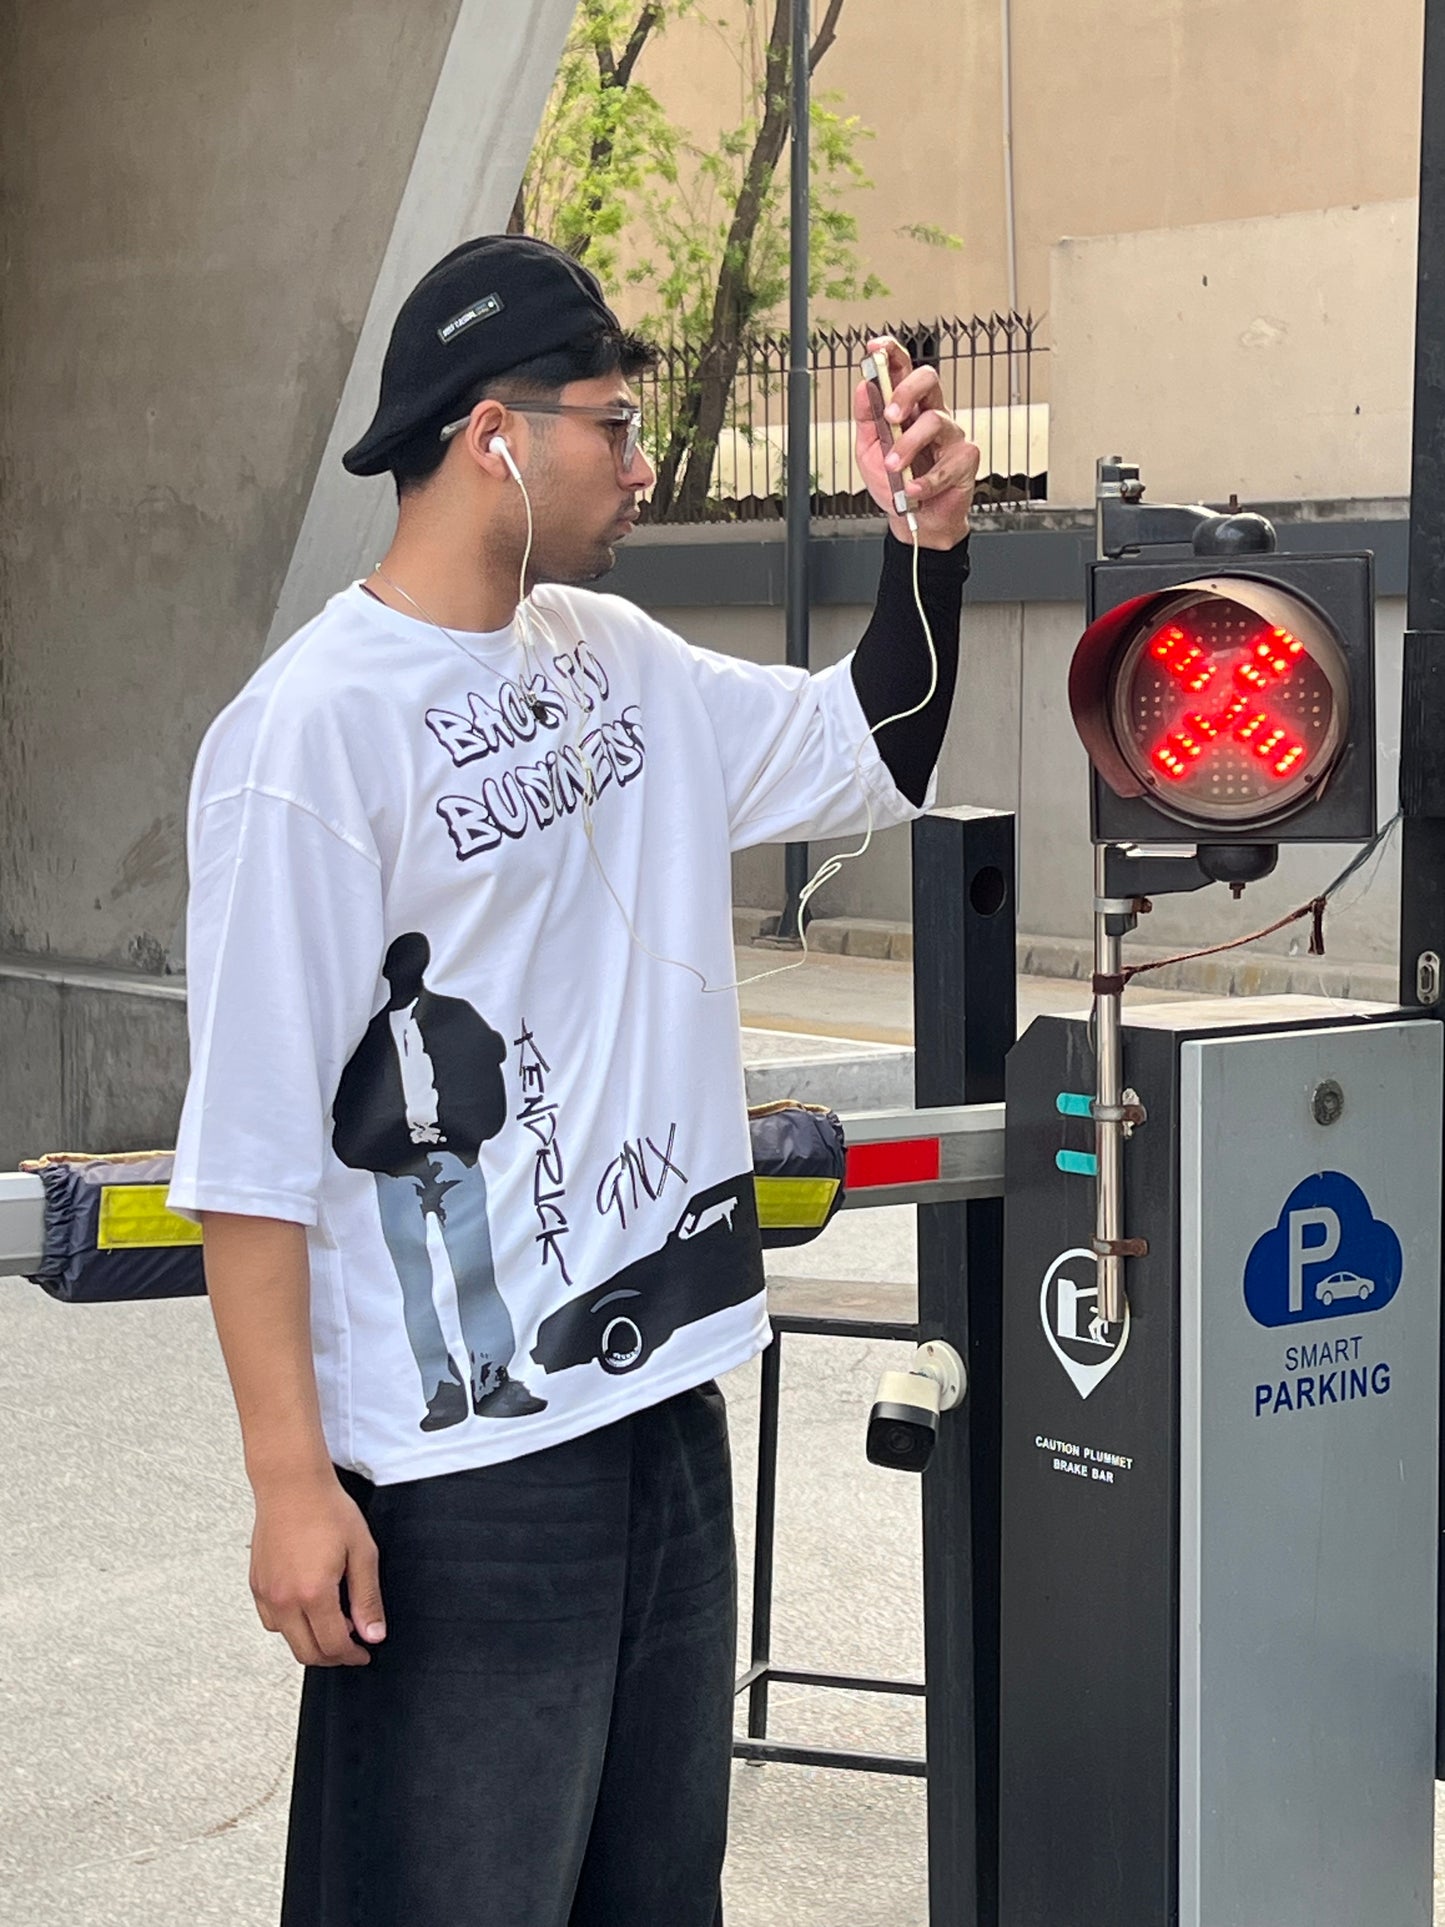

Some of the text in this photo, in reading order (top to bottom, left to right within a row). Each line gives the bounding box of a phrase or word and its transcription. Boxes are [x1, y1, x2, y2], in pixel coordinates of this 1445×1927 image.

[425, 674, 568, 768] BACK
[514, 1017, 573, 1286] KENDRICK
[596, 1123, 688, 1230] GNX
[1289, 1206, 1341, 1312] P
[1256, 1363, 1390, 1417] PARKING
[1285, 1336, 1363, 1371] SMART
[1035, 1435, 1133, 1470] CAUTION PLUMMET
[1053, 1458, 1114, 1484] BRAKE BAR
